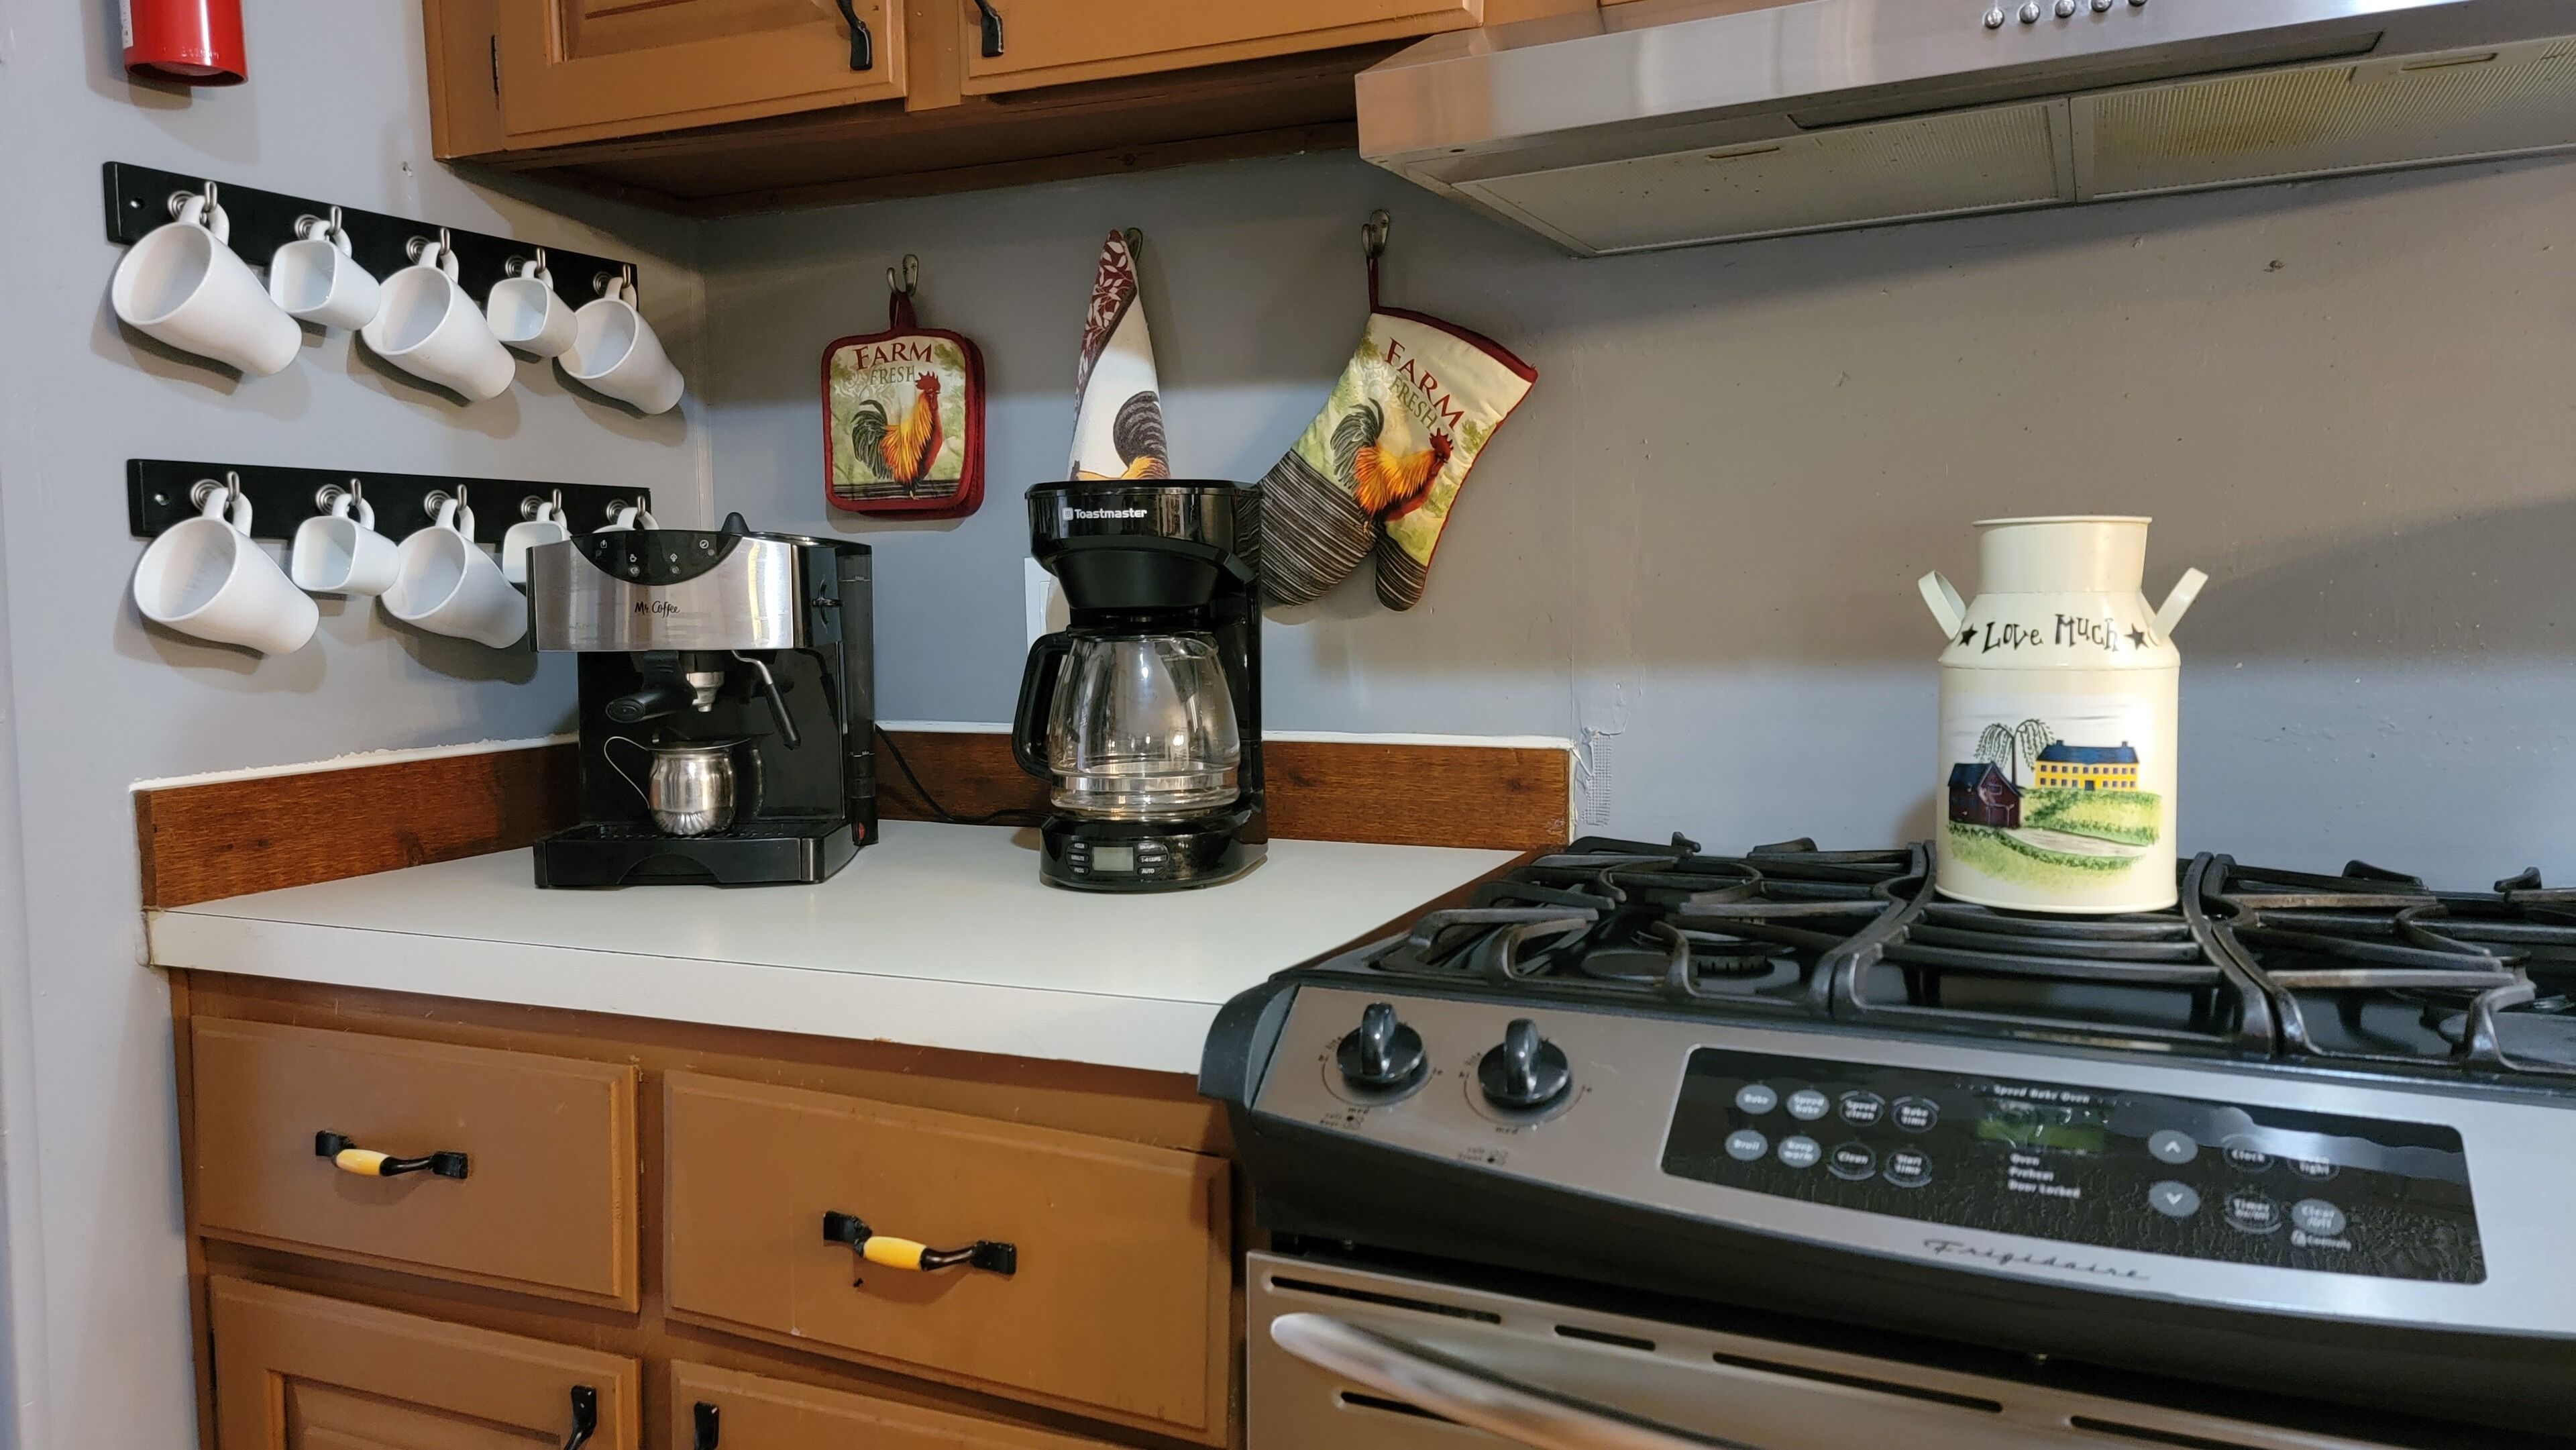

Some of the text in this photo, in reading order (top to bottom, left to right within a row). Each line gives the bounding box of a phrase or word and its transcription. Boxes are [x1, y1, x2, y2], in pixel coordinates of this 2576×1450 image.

[853, 342, 932, 370] FARM
[870, 366, 916, 385] FRESH
[1385, 337, 1464, 431] FARM
[1388, 374, 1438, 431] FRESH
[1074, 507, 1148, 519] Toastmaster
[651, 600, 681, 618] Coffee
[1982, 614, 2121, 654] Love Much
